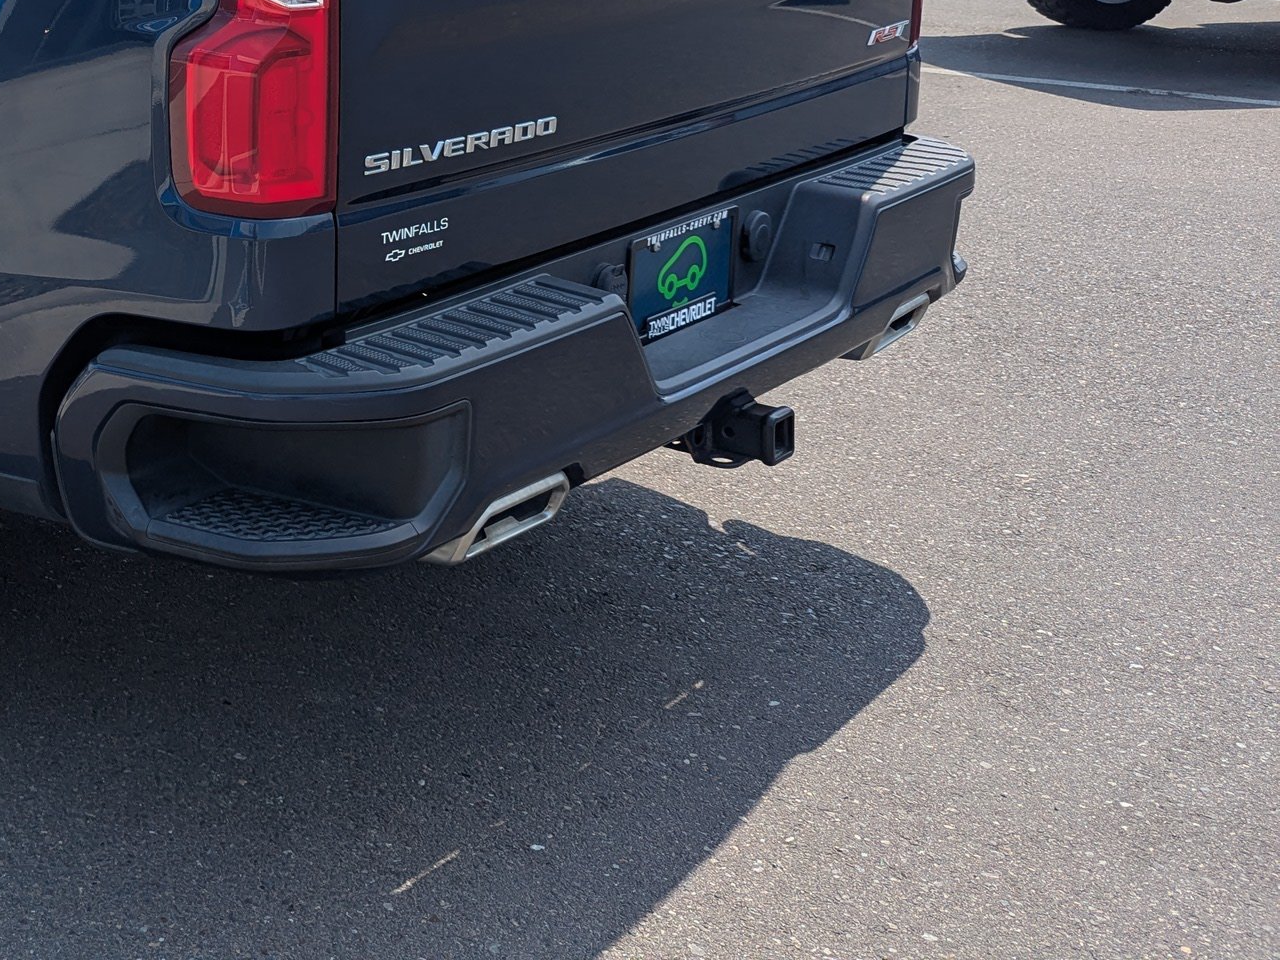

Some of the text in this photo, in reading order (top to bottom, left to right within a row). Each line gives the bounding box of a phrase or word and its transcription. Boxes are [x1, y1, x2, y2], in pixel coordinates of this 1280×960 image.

[867, 20, 910, 46] RST
[364, 116, 558, 176] SILVERADO
[381, 217, 449, 245] TWINFALLS
[647, 210, 728, 247] TWINFALLS-CHEVY.COM
[408, 240, 444, 255] CHEVROLET
[648, 315, 671, 332] TWIN
[669, 297, 717, 330] CHEVROLET
[648, 324, 670, 339] FALLS
